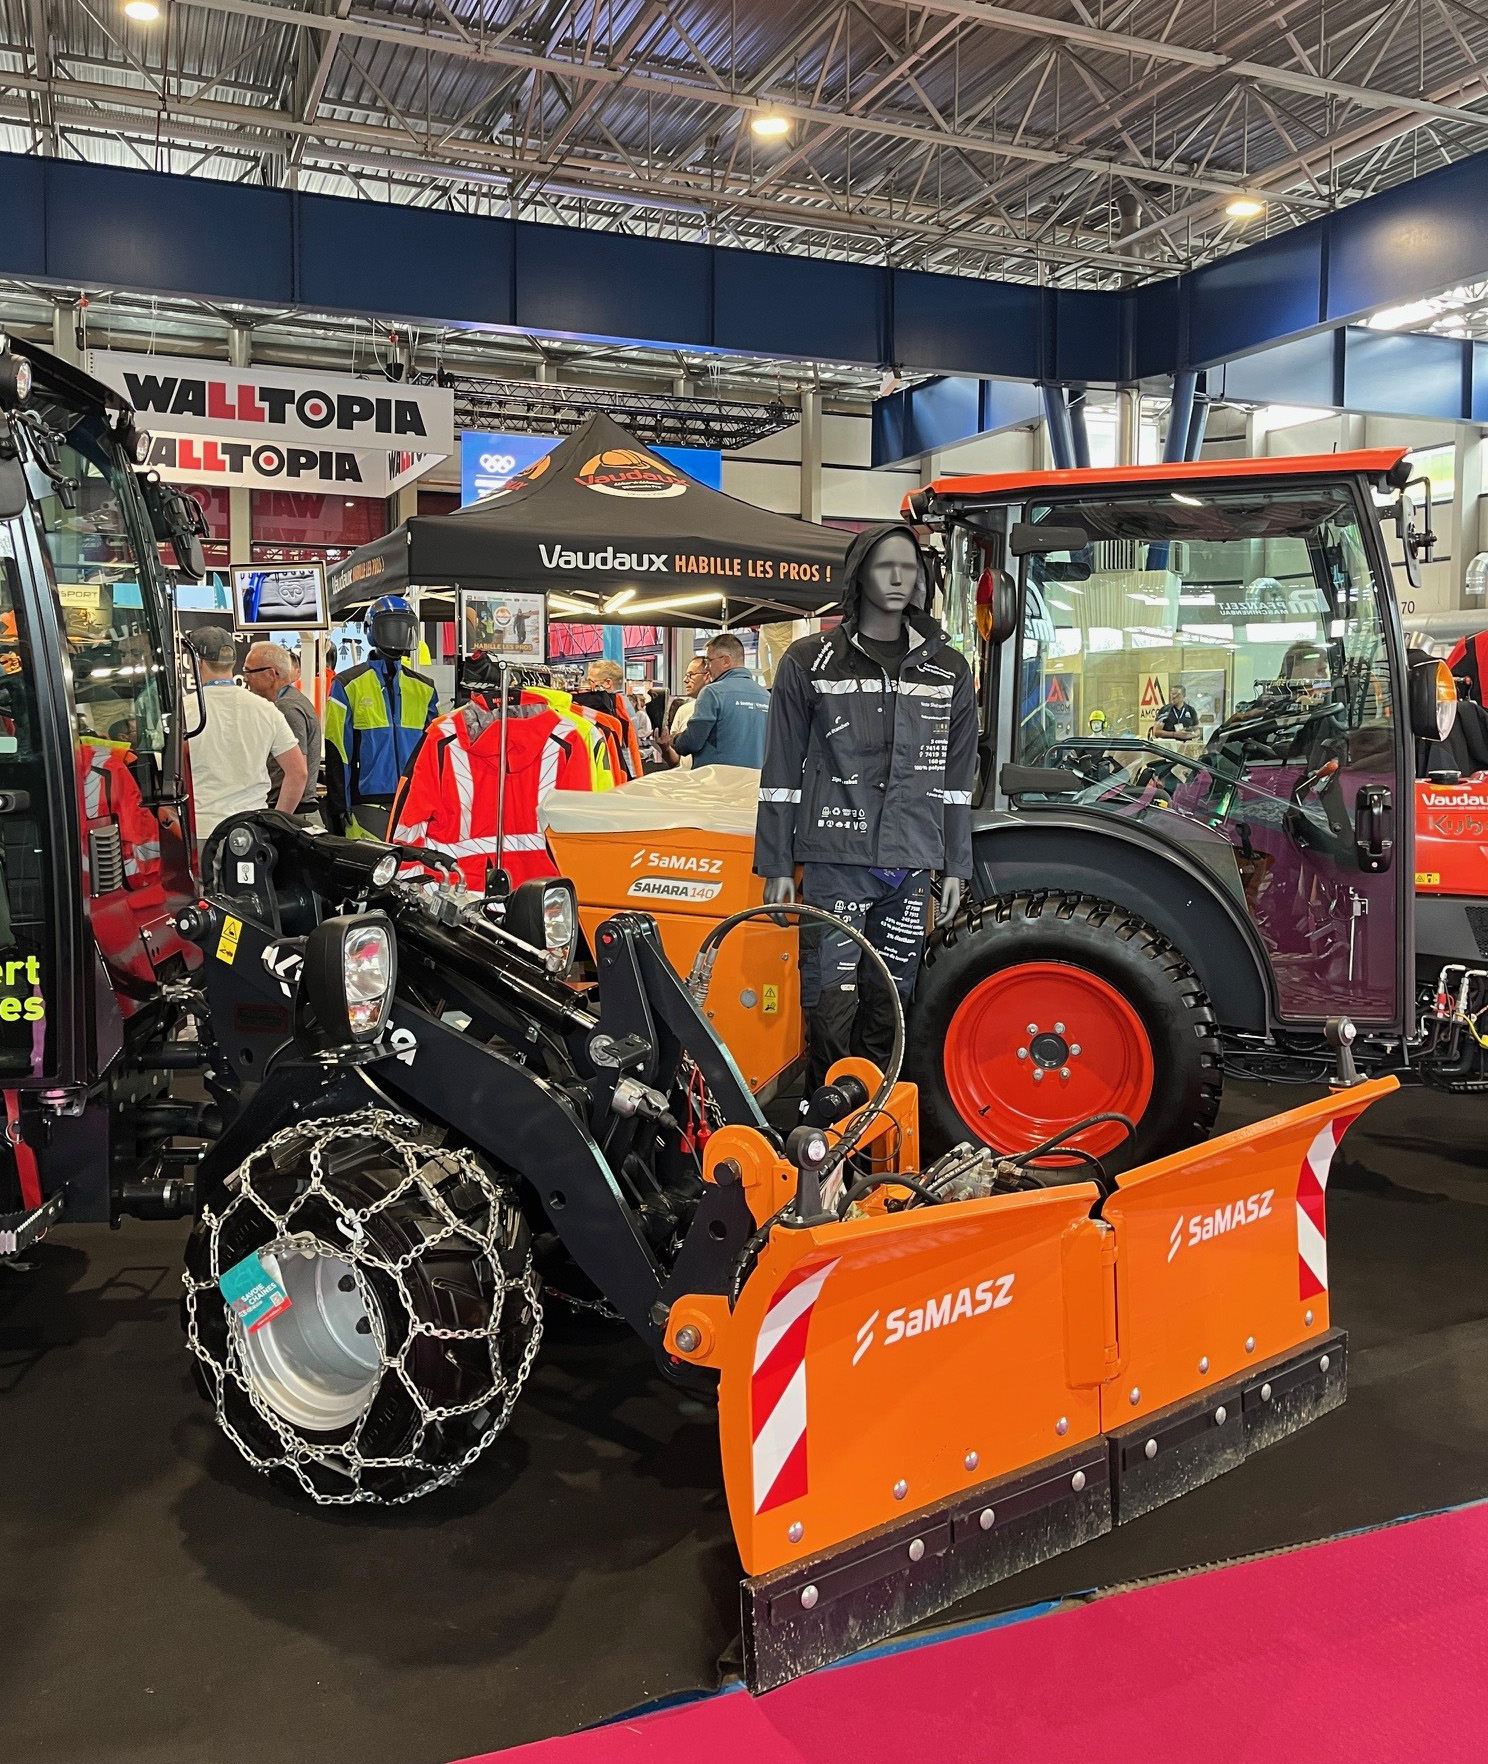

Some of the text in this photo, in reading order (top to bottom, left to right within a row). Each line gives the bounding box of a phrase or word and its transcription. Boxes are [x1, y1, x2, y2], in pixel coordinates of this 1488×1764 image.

[122, 372, 428, 437] WALLTOPIA
[149, 437, 363, 483] ALLTOPIA
[573, 468, 691, 489] Vaudaux
[538, 544, 832, 582] Vaudaux HABILLE LES PROS !
[1401, 601, 1415, 615] 70
[1428, 815, 1488, 835] Kub
[647, 852, 723, 874] SaMASZ
[633, 882, 715, 899] SAHARA 140
[0, 955, 41, 986] rt
[1187, 1188, 1275, 1247] SaMASZ
[240, 1282, 265, 1303] SAVOIE
[883, 1273, 1016, 1346] SaMASZ
